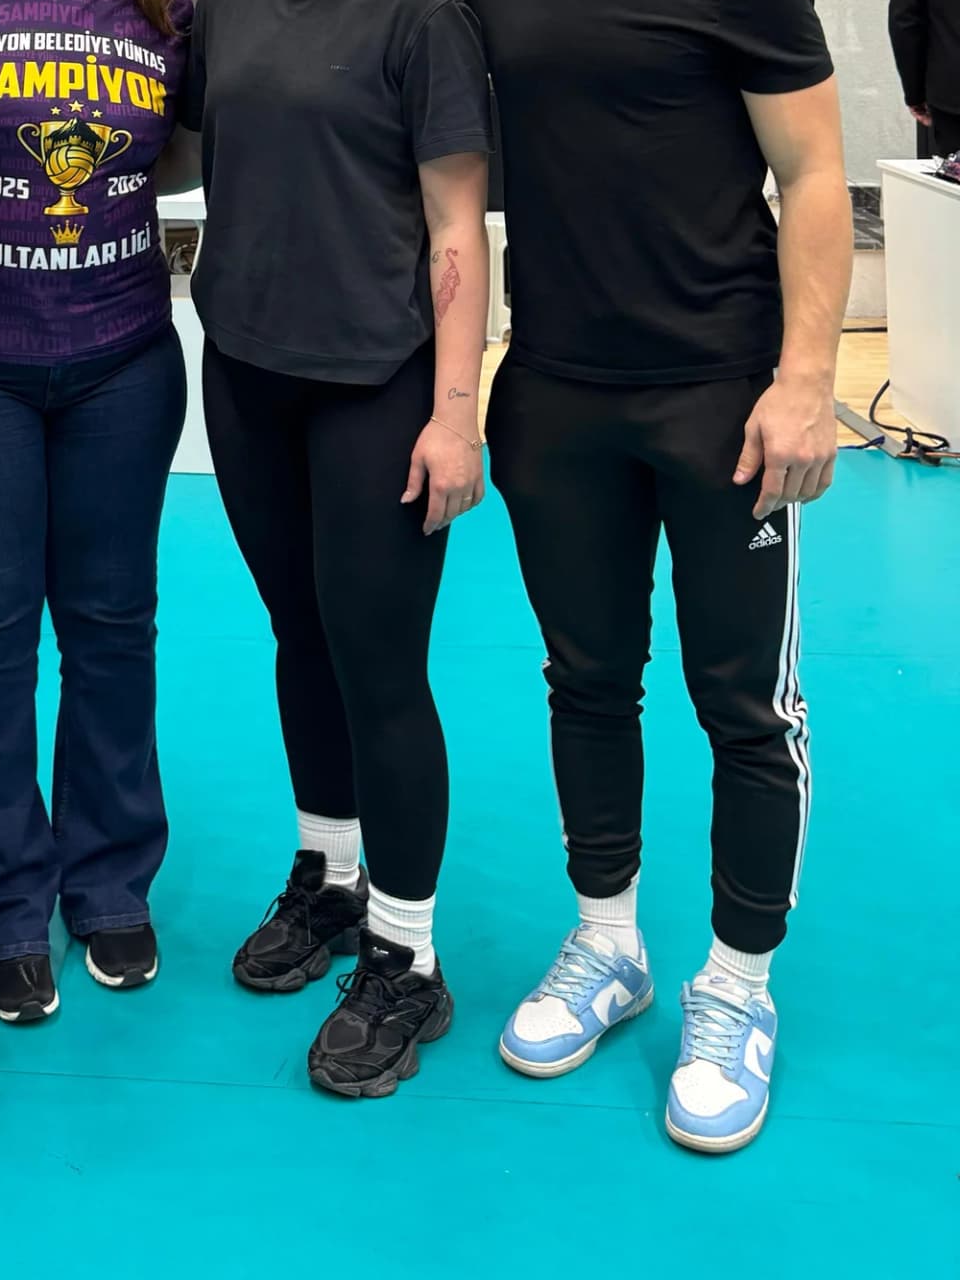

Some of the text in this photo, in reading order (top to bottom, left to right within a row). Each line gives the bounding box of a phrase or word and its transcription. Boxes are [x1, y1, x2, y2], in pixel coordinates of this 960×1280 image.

[34, 29, 111, 56] BELEDİYE
[114, 38, 166, 76] YÜNTAŞ
[121, 224, 151, 261] LİGİ
[748, 535, 782, 550] adidas
